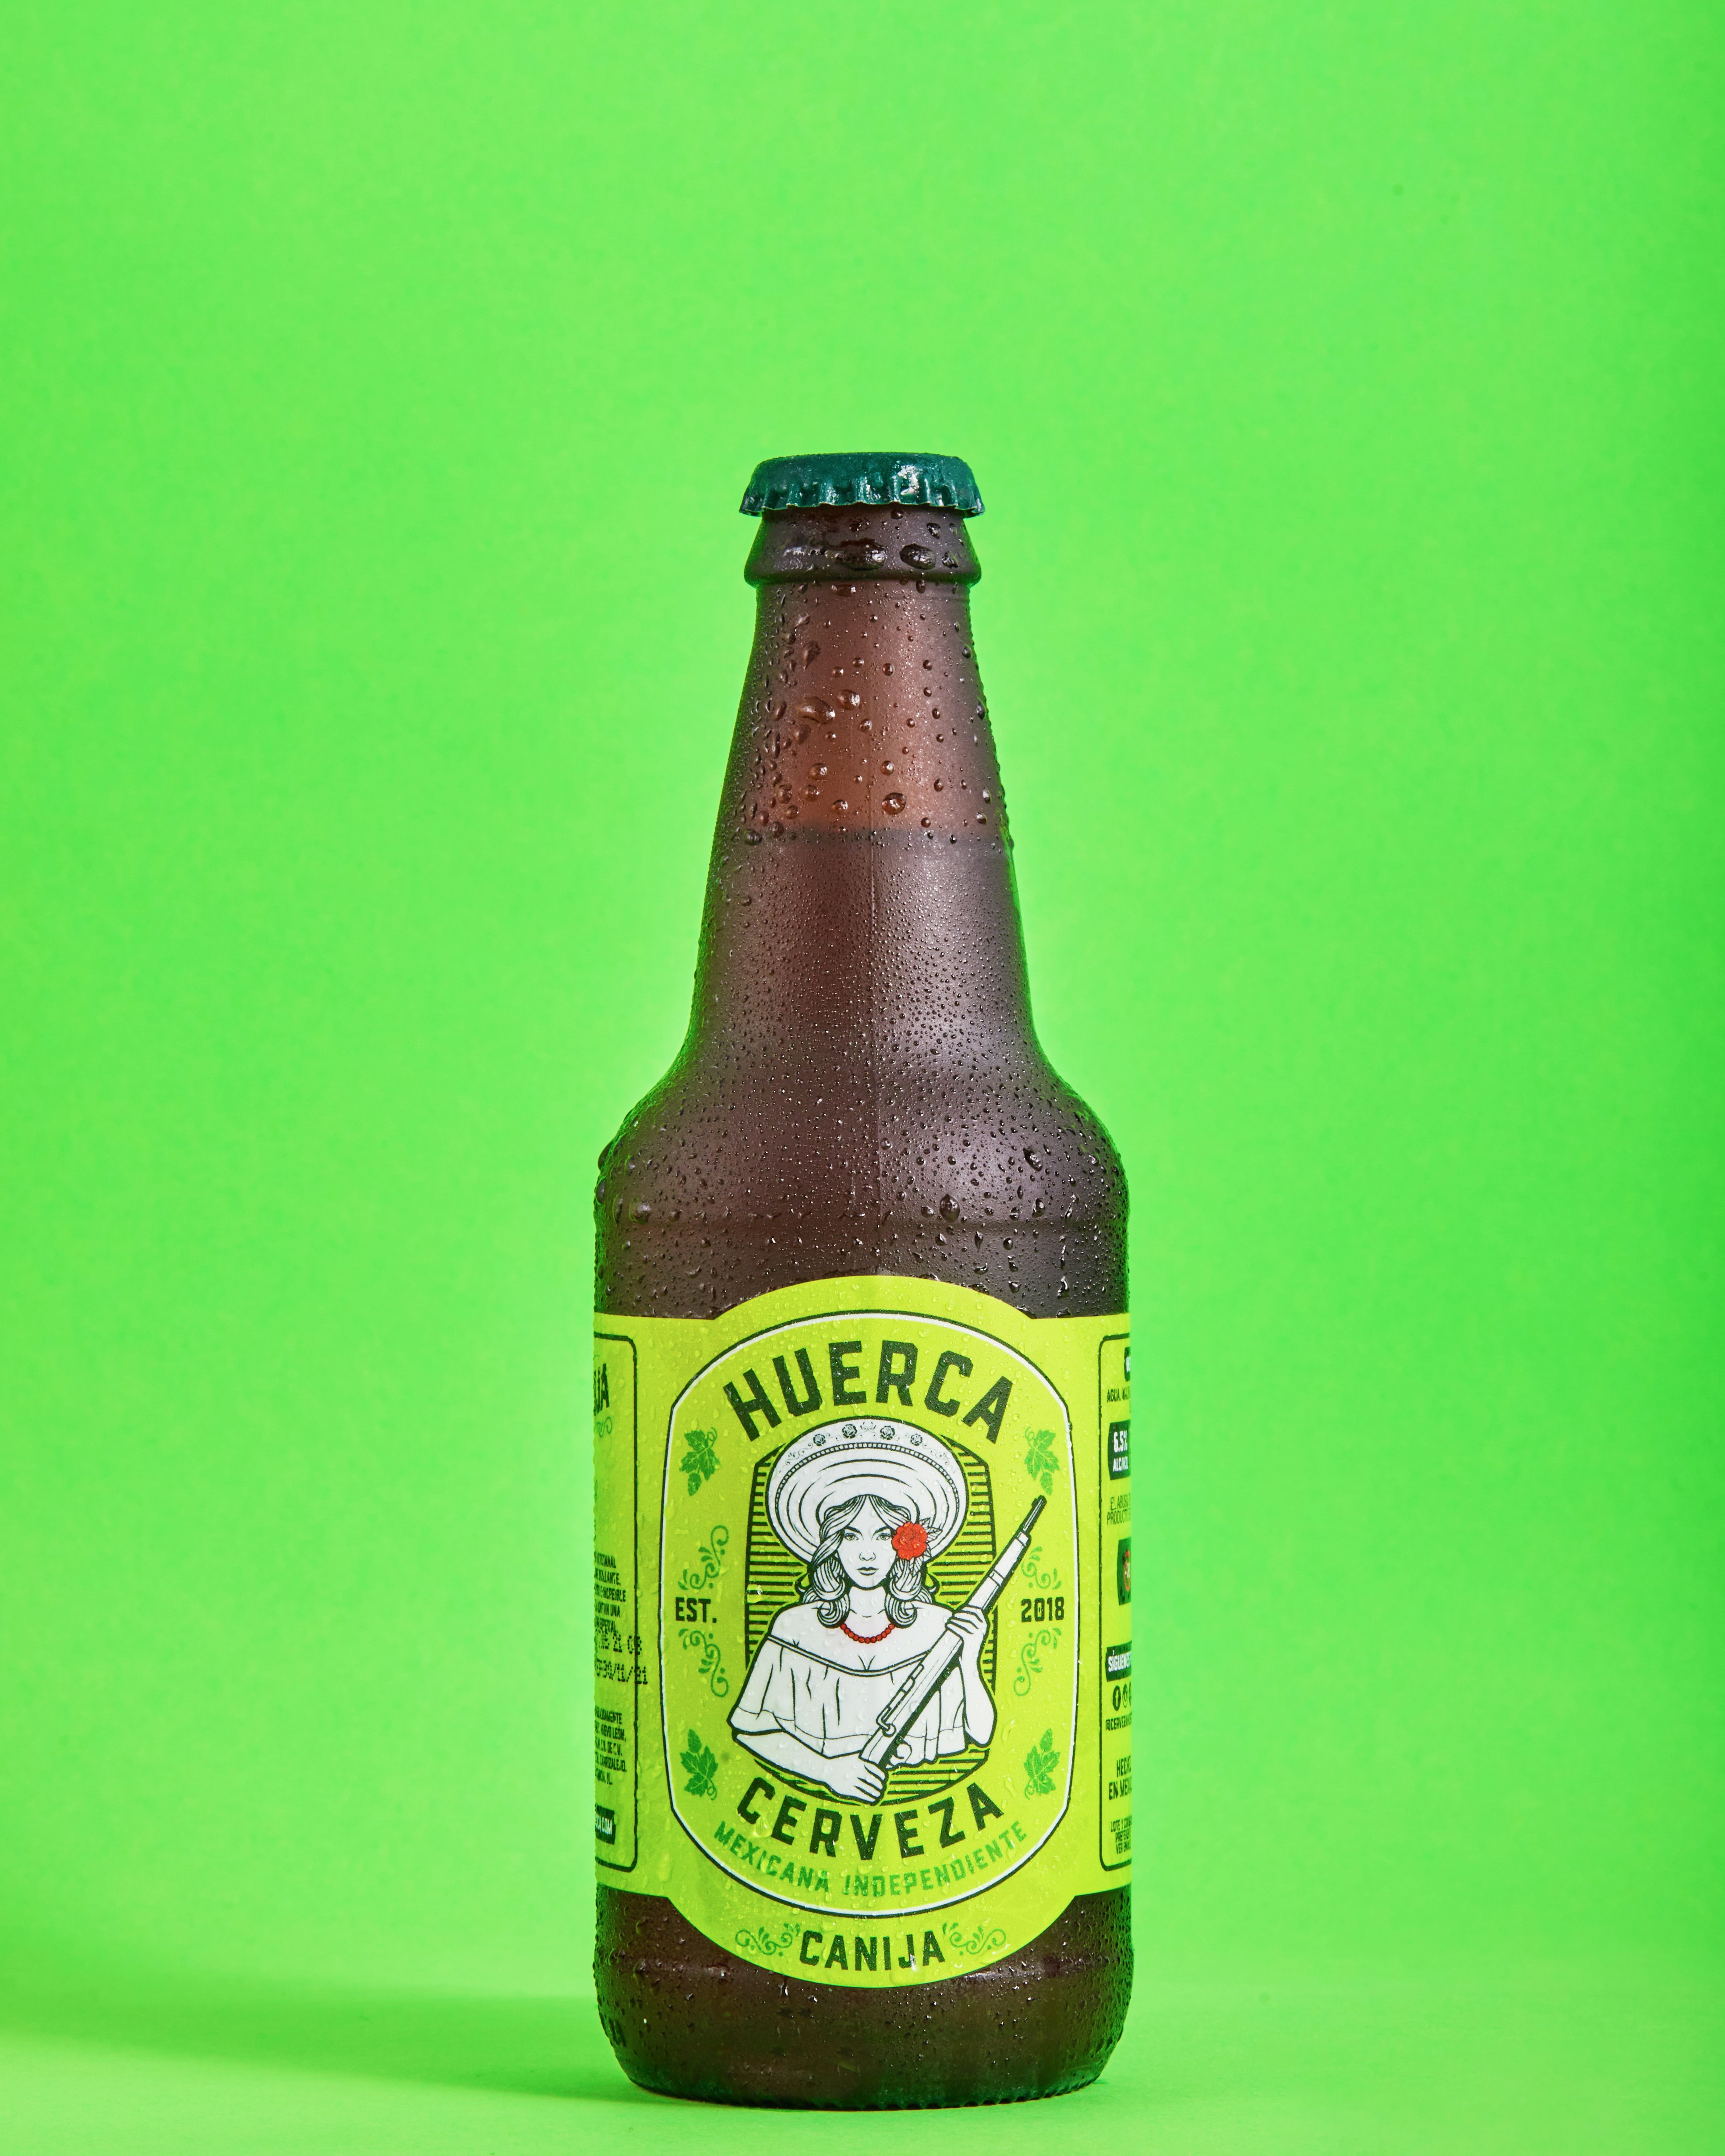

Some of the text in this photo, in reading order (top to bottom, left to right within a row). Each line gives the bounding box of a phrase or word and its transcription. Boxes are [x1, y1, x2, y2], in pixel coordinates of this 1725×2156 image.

[723, 1340, 1013, 1444] HUERCA
[675, 1597, 717, 1623] EST.
[1021, 1597, 1065, 1622] 2018
[1109, 1781, 1118, 1800] EN
[737, 1777, 1004, 1860] CERVEZA
[714, 1820, 1028, 1897] MEXICANA INDEPENDIENTE
[799, 1930, 946, 1971] CANIJA
